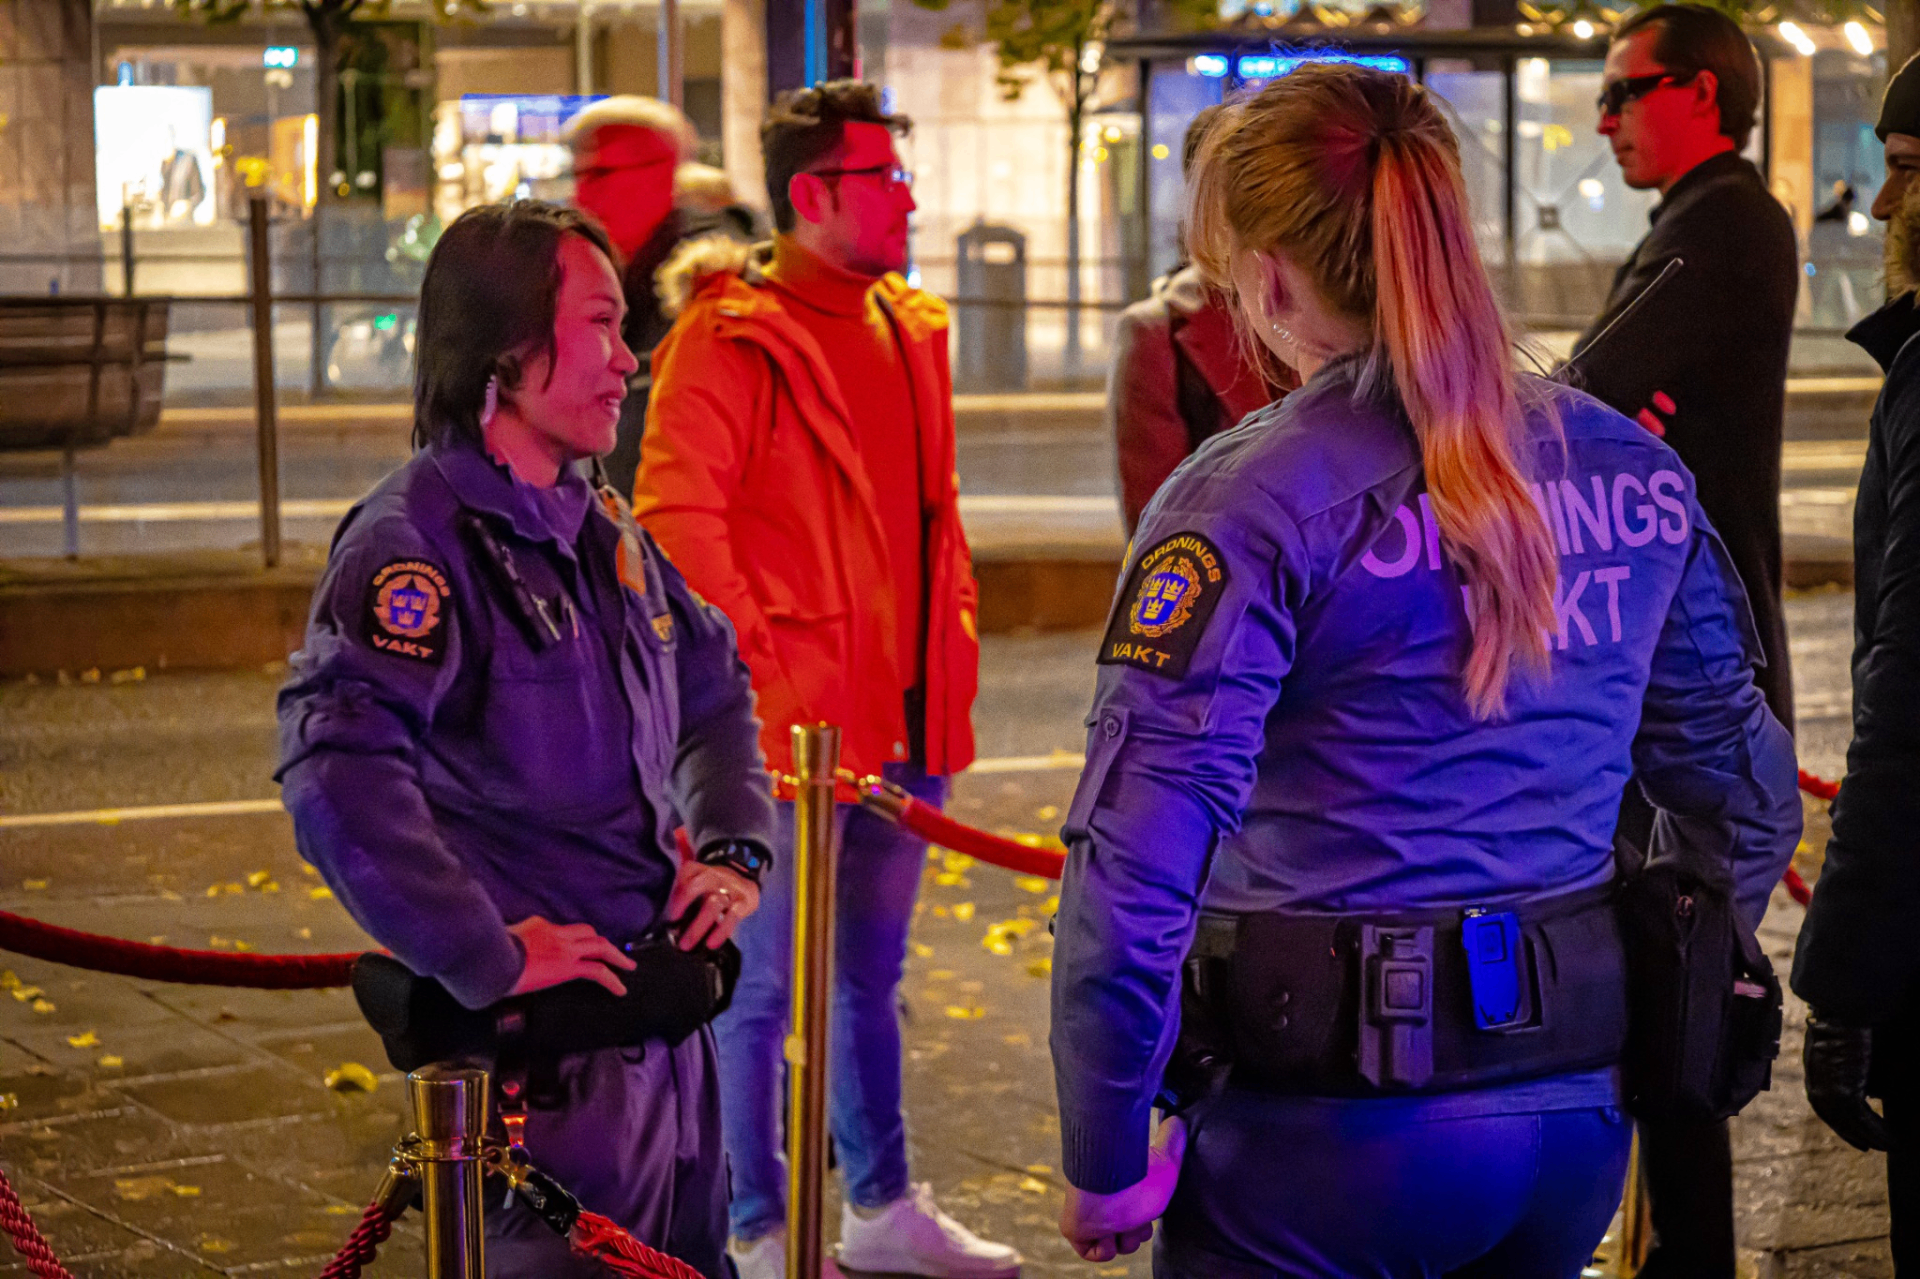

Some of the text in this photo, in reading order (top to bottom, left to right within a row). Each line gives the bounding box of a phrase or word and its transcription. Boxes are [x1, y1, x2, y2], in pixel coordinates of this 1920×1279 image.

[1361, 470, 1688, 578] OINGS
[1141, 537, 1221, 582] ORDNINGS
[1460, 566, 1631, 651] KT
[372, 634, 433, 658] VAKT
[1112, 643, 1170, 667] VAKT
